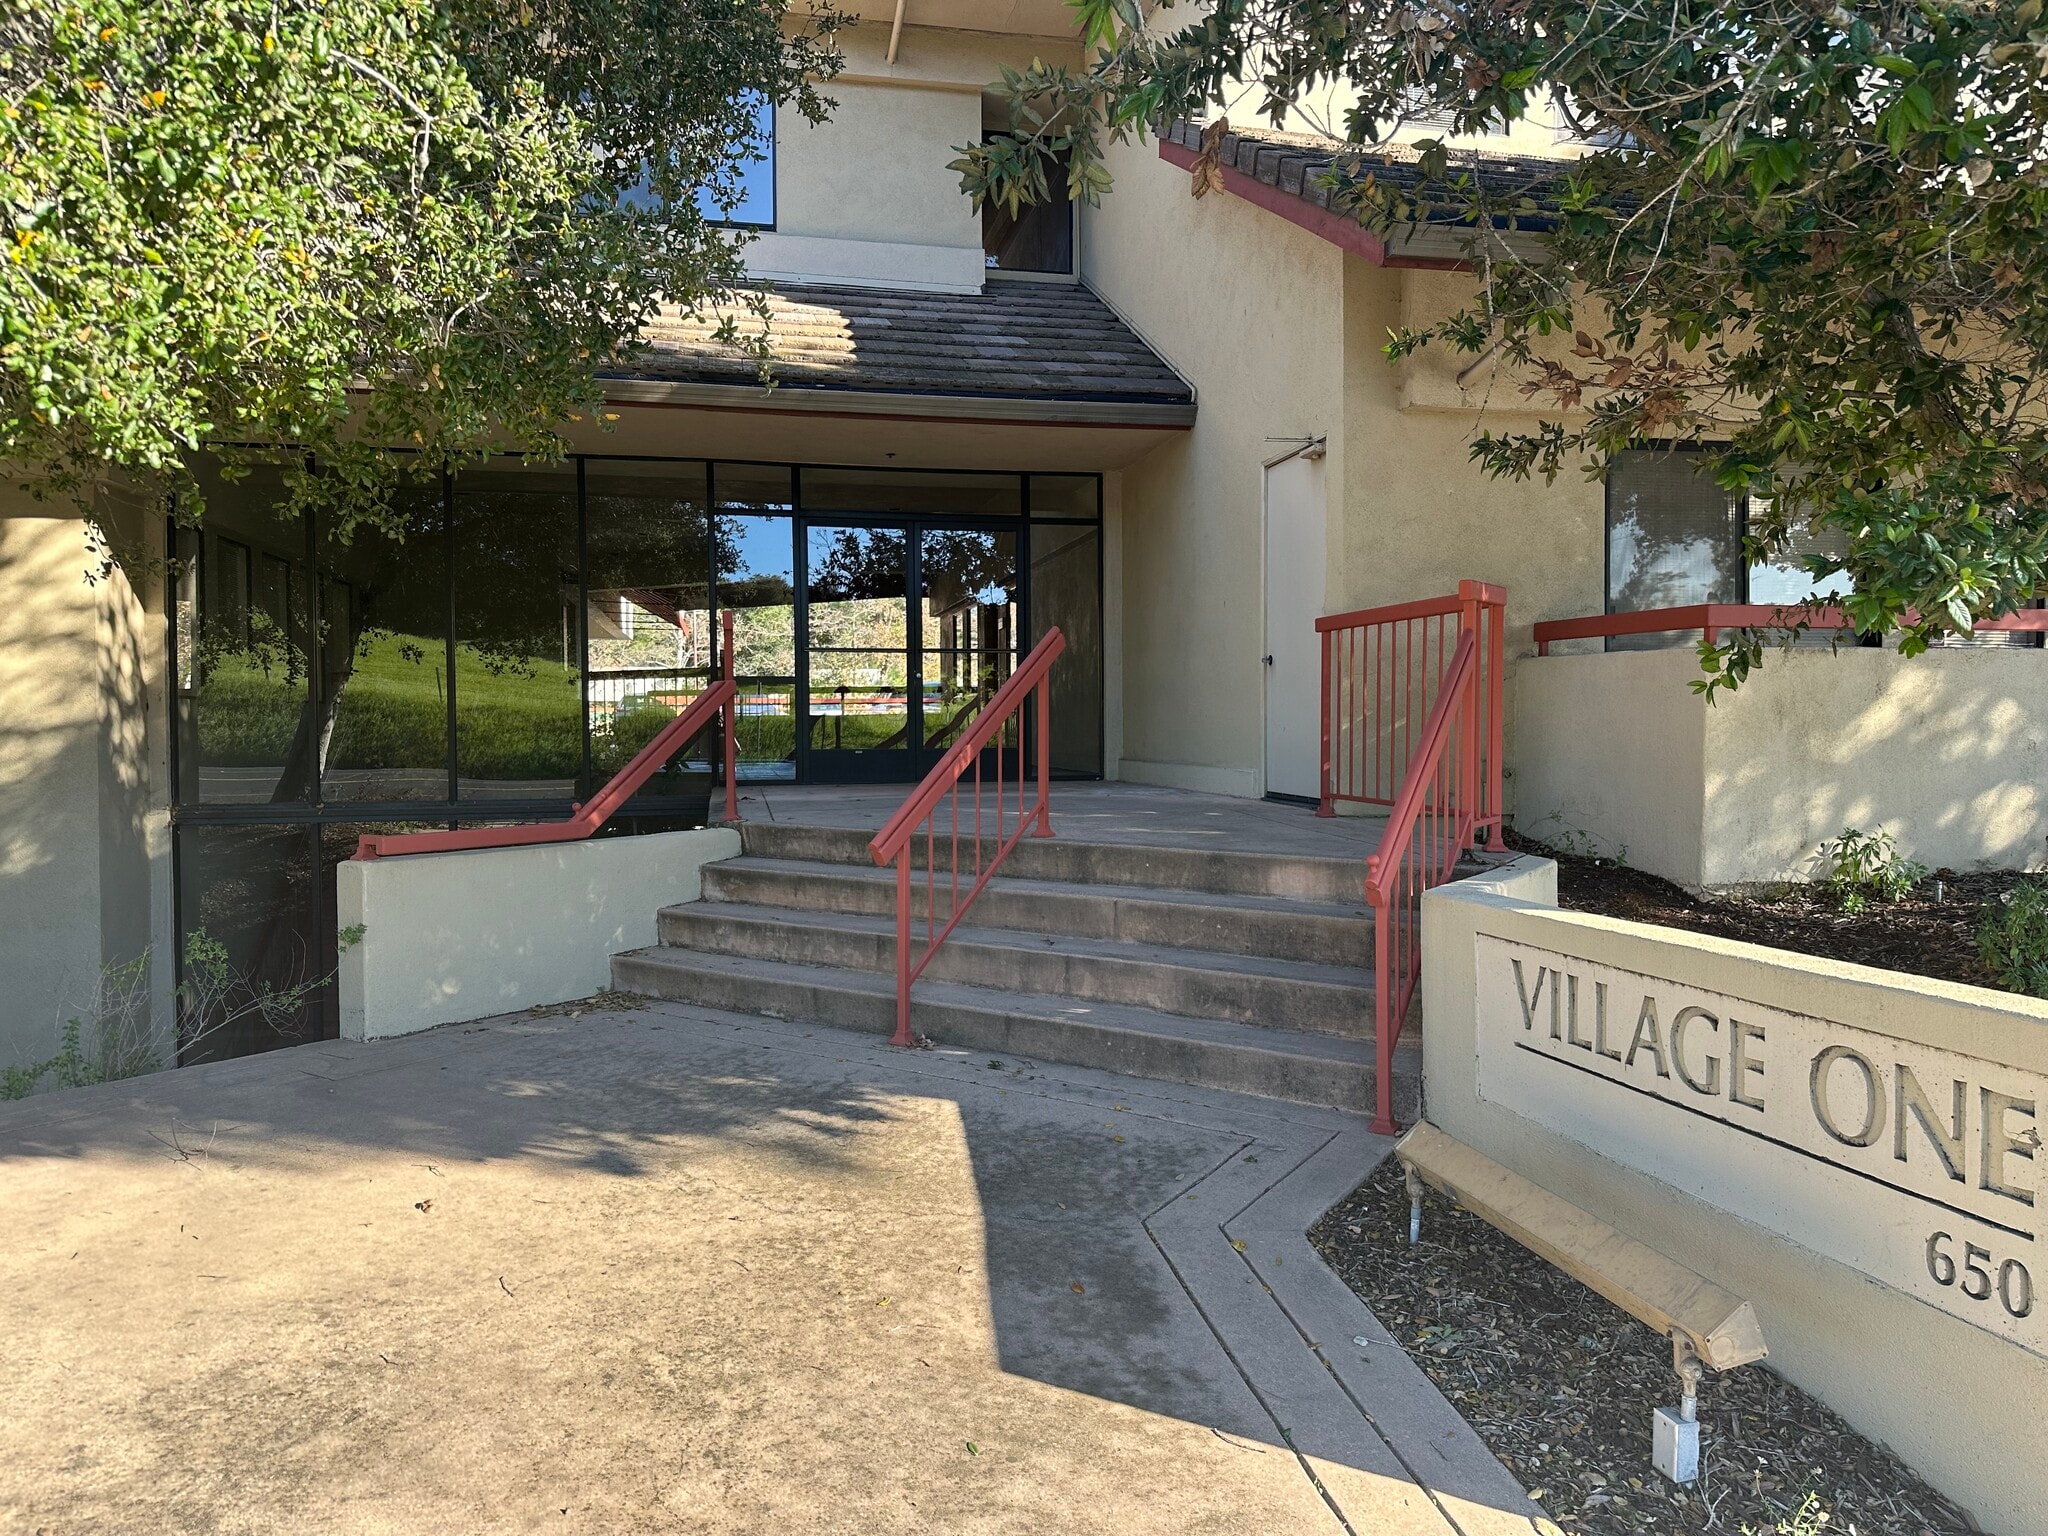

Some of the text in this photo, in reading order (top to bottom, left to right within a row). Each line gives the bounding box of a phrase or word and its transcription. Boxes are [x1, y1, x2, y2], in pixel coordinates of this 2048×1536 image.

[1511, 958, 2036, 1208] VILLAGE ONE
[1925, 1231, 2034, 1319] 650
